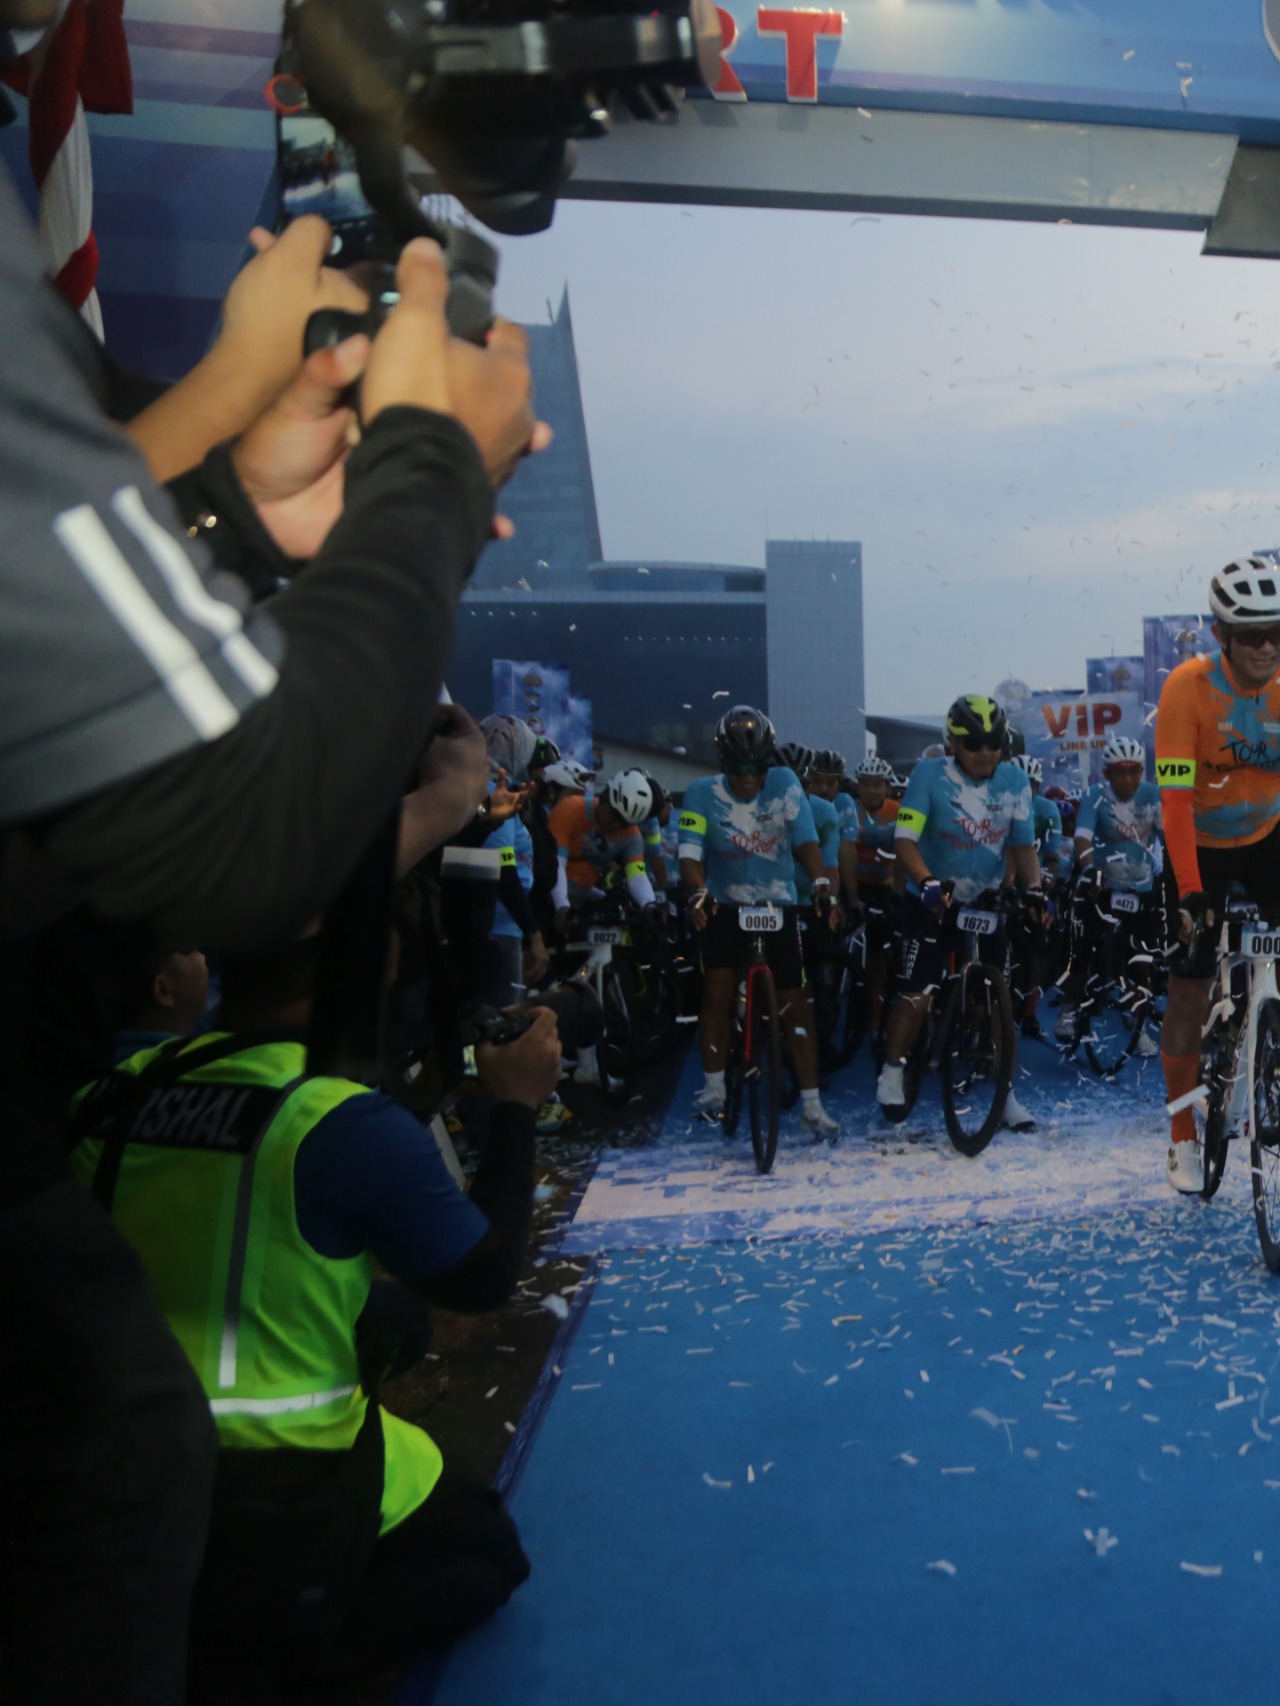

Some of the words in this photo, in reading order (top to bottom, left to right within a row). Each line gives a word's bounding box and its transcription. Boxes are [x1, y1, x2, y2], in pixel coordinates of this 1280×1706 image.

[1060, 741, 1088, 751] LINE
[1158, 763, 1191, 777] VIP
[745, 915, 776, 930] 0005
[963, 916, 990, 932] 1673
[594, 932, 617, 943] 0022
